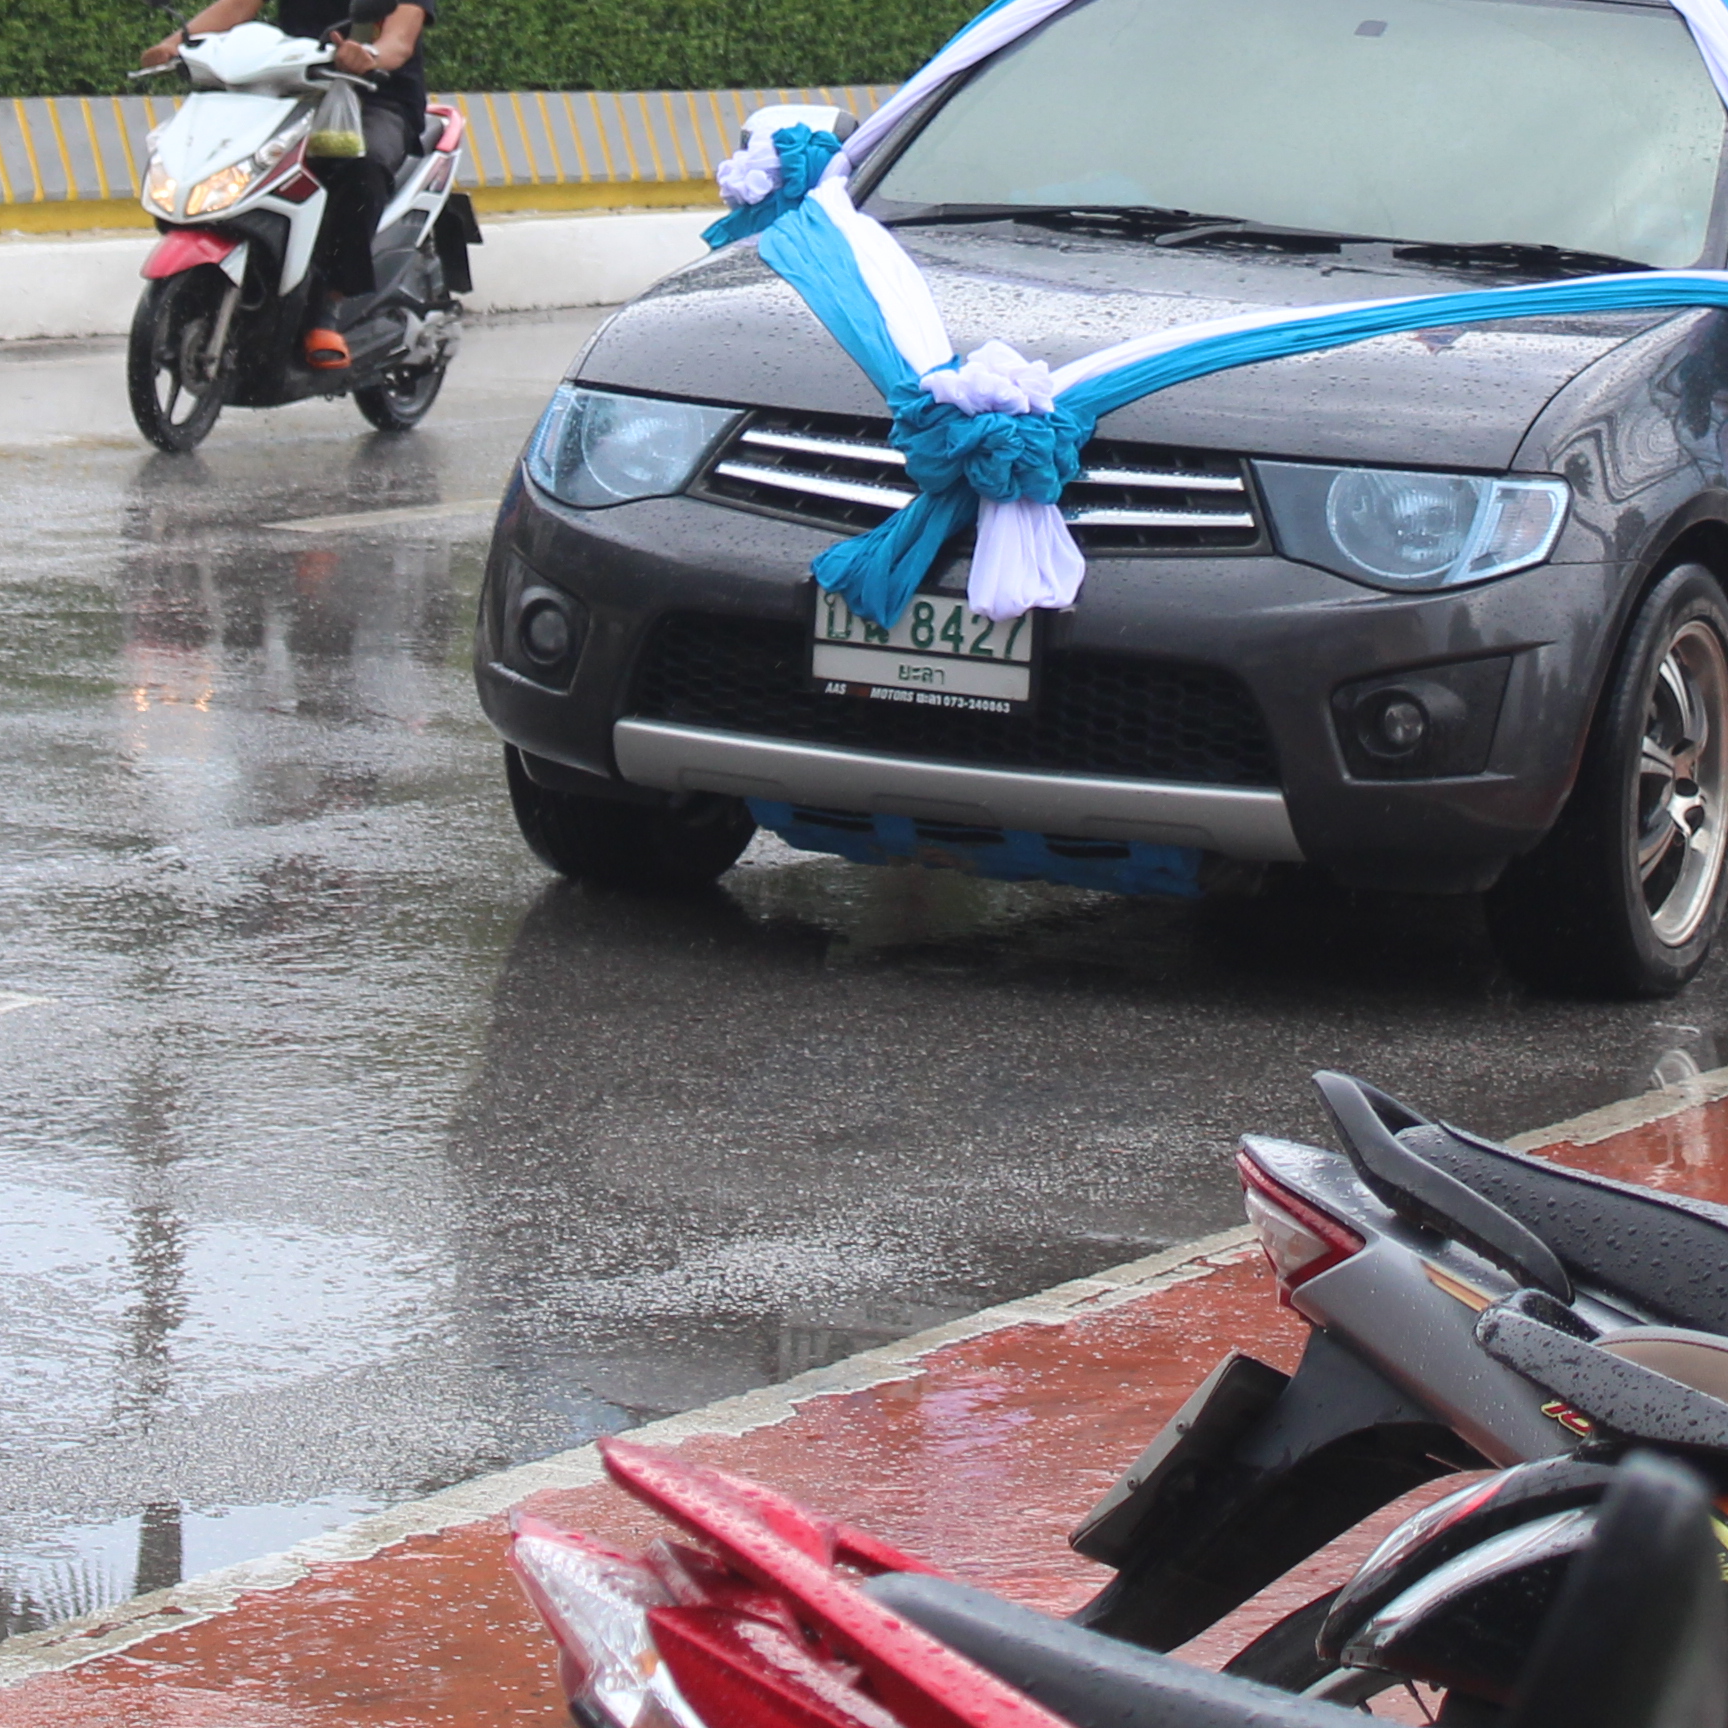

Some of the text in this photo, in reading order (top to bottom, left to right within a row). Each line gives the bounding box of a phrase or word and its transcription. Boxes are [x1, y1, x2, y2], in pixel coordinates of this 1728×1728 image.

[910, 601, 1027, 659] 8427
[898, 665, 945, 686] ยะลา
[870, 687, 914, 703] MOTORS
